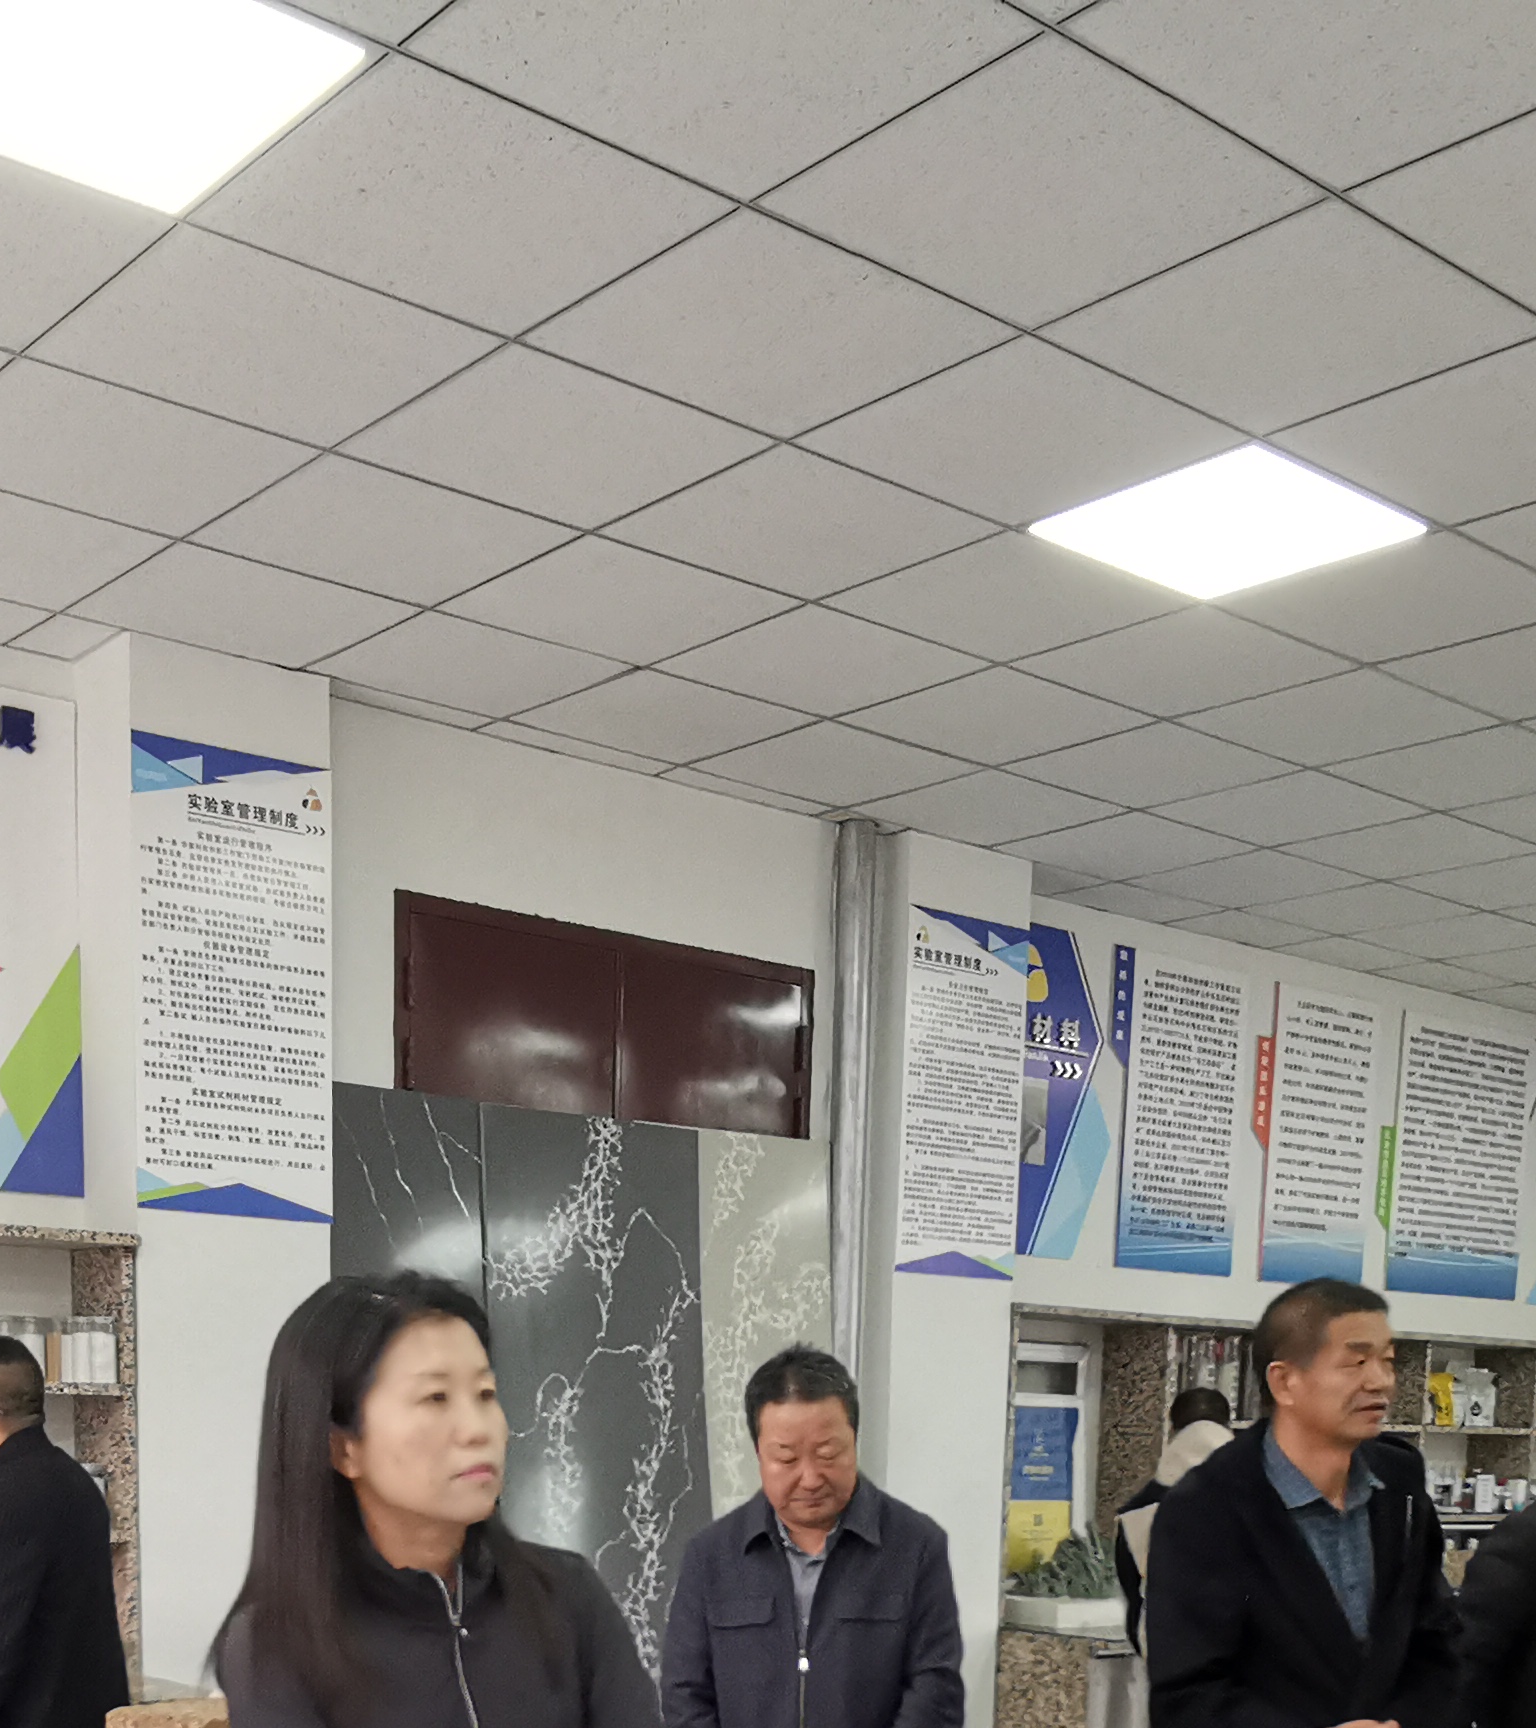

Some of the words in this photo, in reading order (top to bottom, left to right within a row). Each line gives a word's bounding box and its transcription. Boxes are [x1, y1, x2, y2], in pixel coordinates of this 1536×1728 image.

[187, 794, 299, 830] 实验室管理制度
